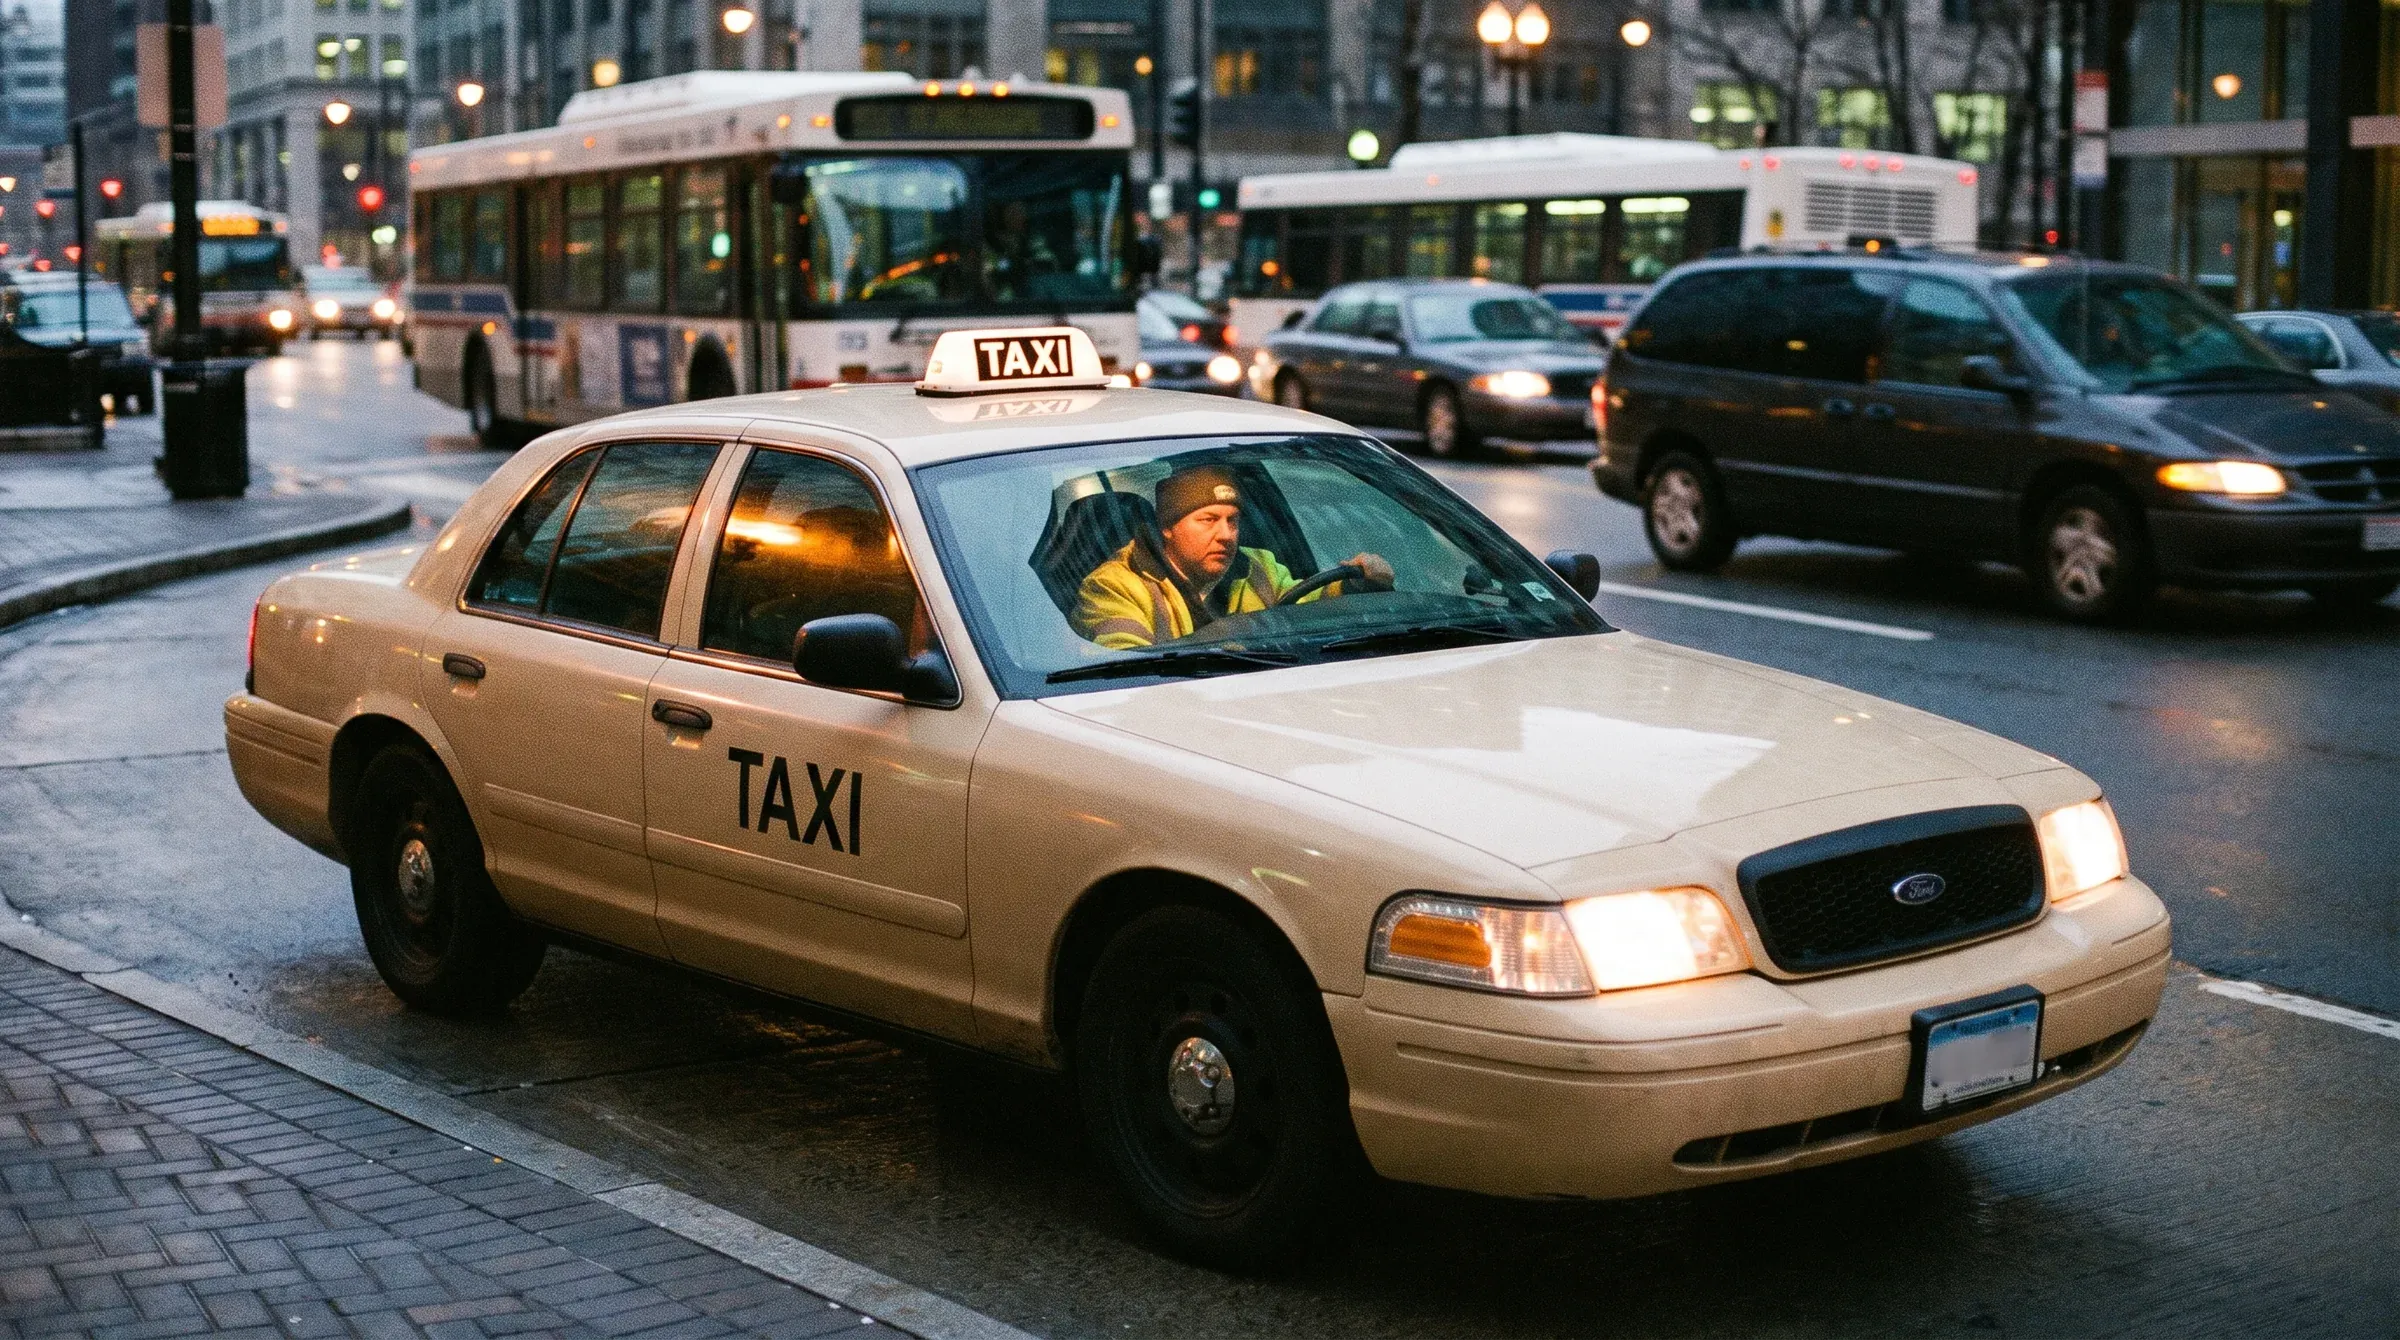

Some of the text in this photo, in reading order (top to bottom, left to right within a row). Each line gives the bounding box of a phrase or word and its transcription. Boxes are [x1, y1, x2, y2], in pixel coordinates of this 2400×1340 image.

[979, 339, 1069, 377] TAXI
[728, 746, 863, 857] TAXI
[1908, 880, 1936, 899] Ford
